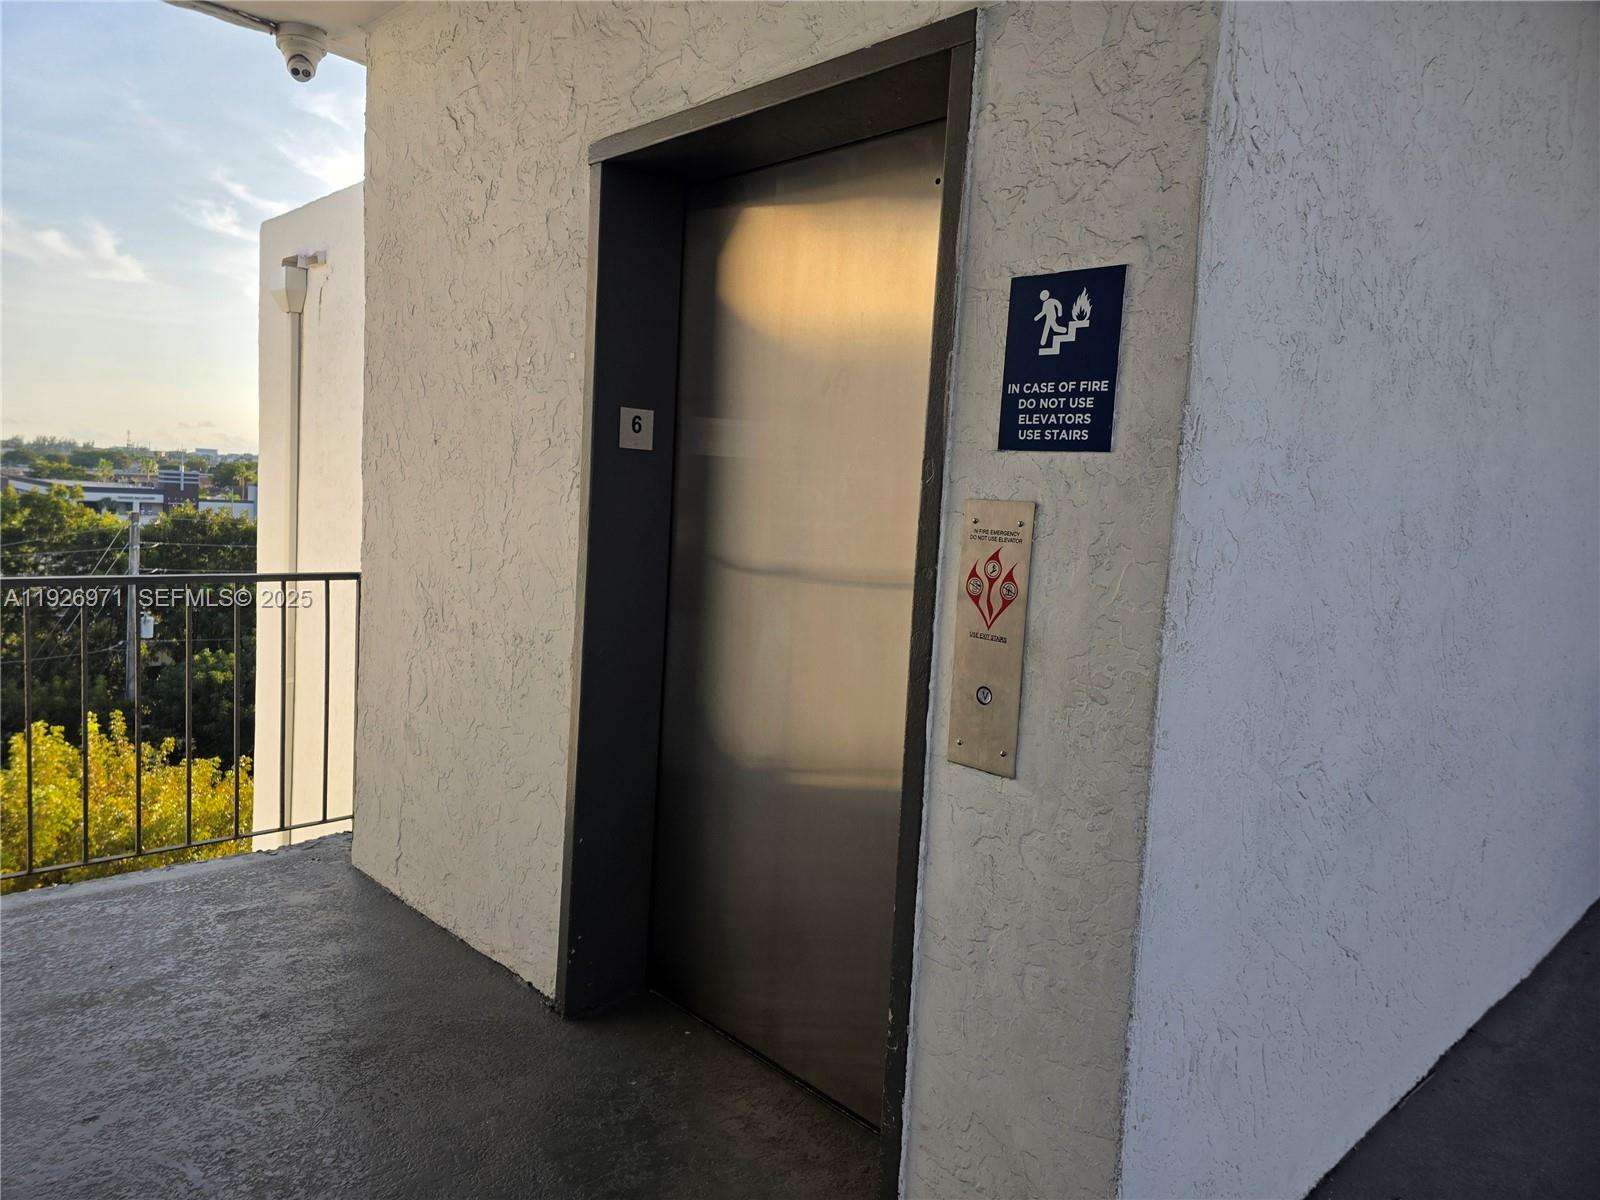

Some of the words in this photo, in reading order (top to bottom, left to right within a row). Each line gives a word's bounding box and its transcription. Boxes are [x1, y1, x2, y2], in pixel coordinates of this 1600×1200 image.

[1007, 383, 1020, 394] IN
[1023, 382, 1055, 394] CASE
[1058, 381, 1077, 393] OF
[1079, 380, 1109, 392] FIRE
[1018, 398, 1036, 409] DO
[1039, 398, 1066, 409] NOT
[1069, 397, 1094, 409] USE
[632, 415, 642, 433] 6
[1018, 413, 1092, 425] ELEVATORS
[1018, 429, 1042, 440] USE
[1044, 429, 1089, 441] STAIRS
